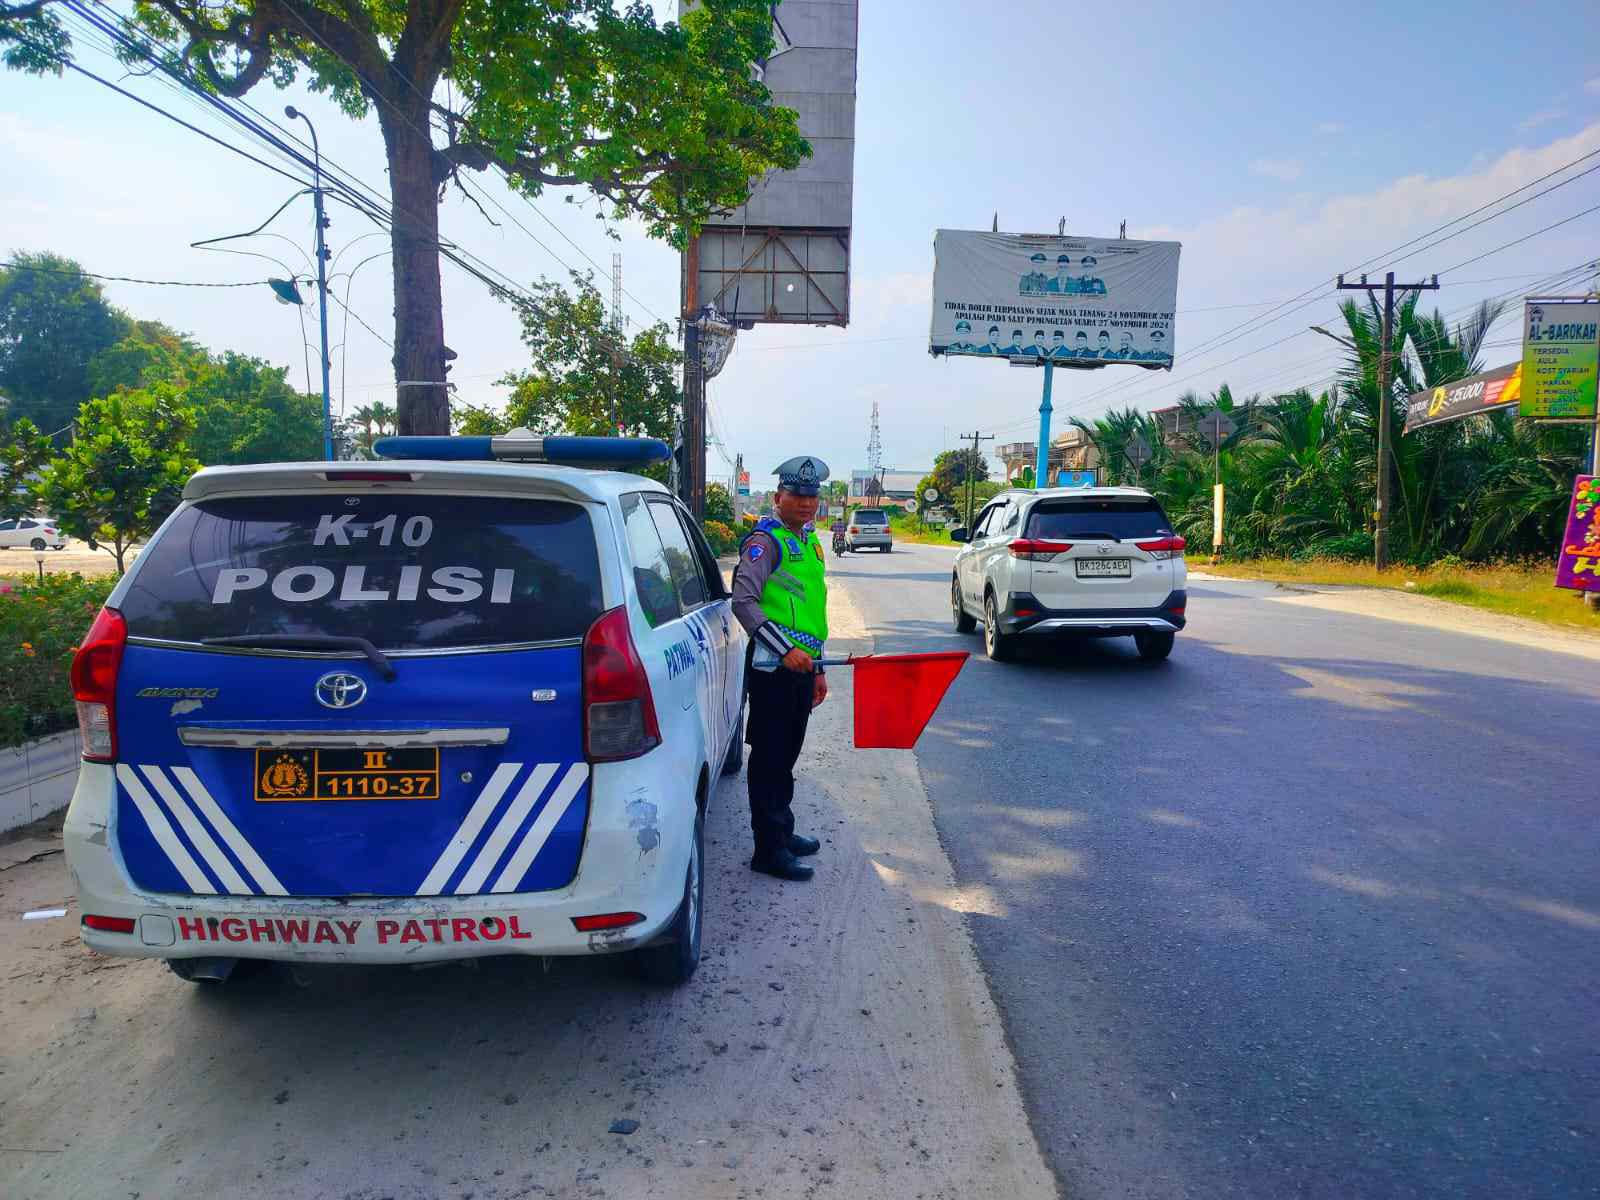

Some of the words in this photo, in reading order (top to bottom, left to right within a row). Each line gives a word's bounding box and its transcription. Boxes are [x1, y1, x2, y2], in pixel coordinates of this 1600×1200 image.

[1529, 323, 1597, 340] AL-BAROKAH
[313, 514, 433, 547] K-10
[212, 565, 515, 604] POLISI
[363, 751, 387, 769] II
[327, 777, 431, 795] 1110-37
[177, 915, 362, 945] HIGHWAY
[376, 915, 532, 945] PATROL
